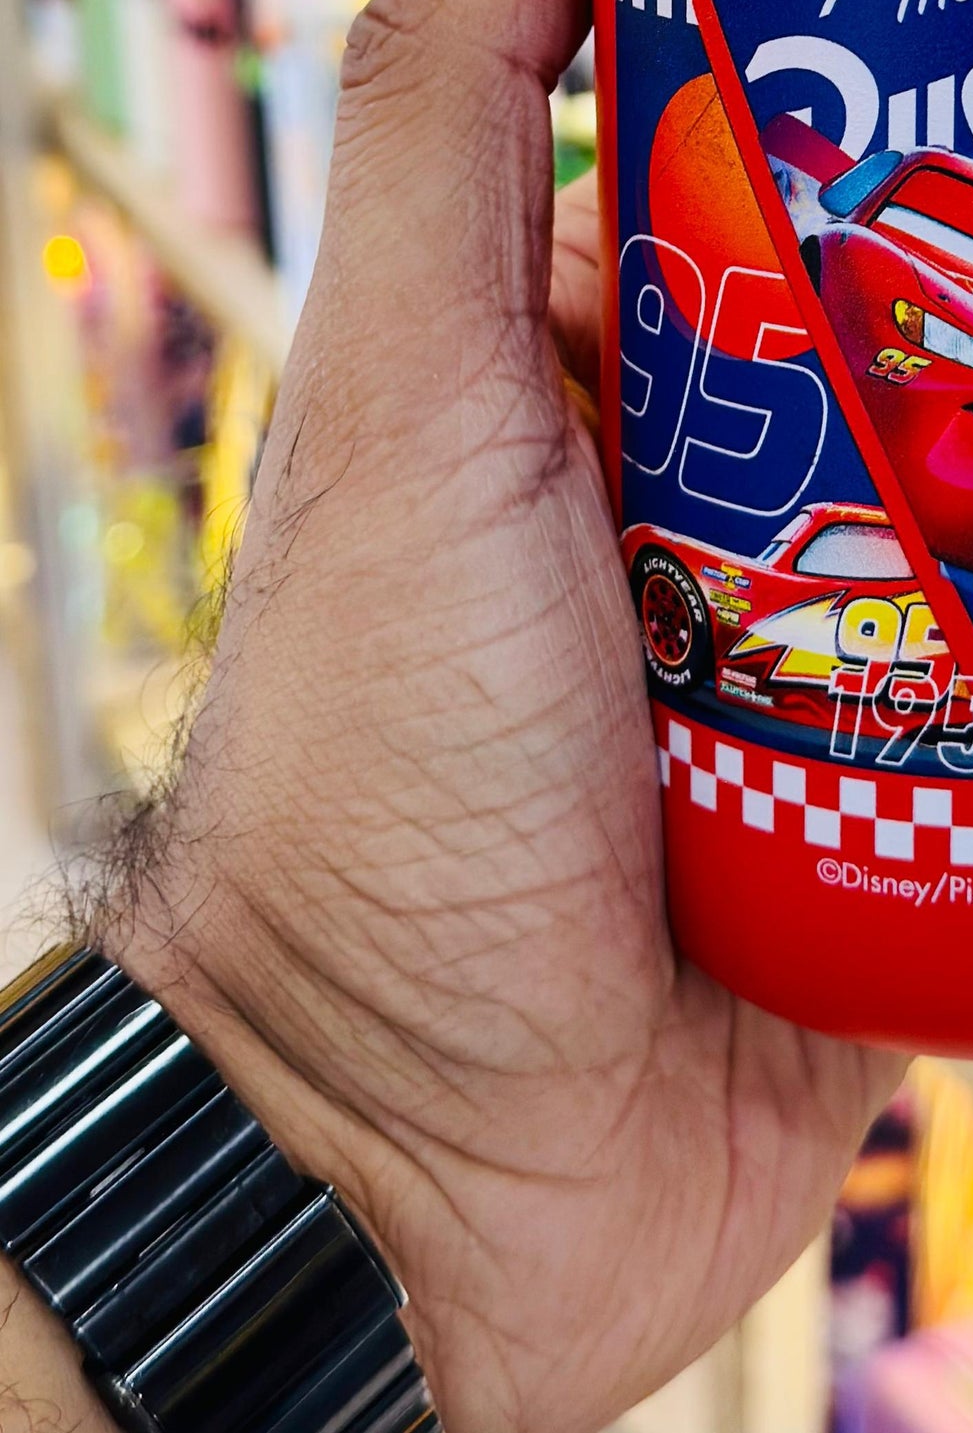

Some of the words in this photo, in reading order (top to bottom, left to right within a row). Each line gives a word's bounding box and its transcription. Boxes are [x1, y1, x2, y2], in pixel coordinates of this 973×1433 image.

[619, 233, 829, 516] 95
[865, 347, 933, 386] 95
[643, 557, 703, 623] LIGHTYEAR
[645, 645, 692, 686] LIGHTY
